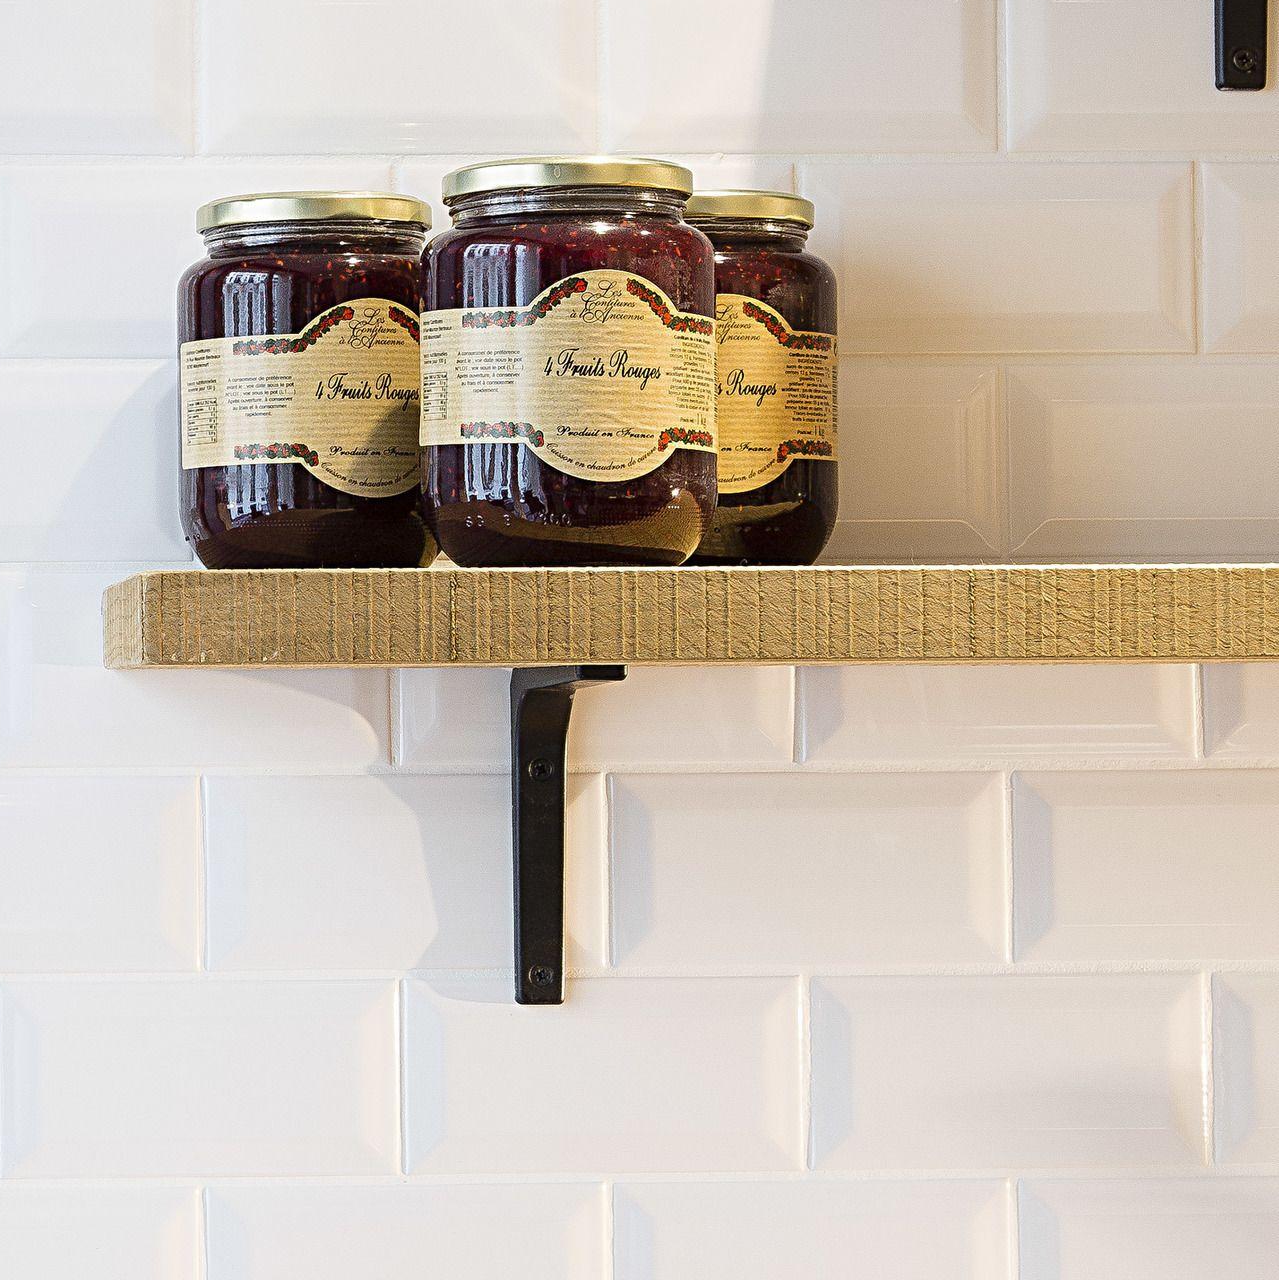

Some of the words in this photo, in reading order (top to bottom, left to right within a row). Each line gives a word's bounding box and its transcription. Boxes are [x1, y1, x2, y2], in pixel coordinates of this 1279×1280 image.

[598, 280, 622, 298] Les
[581, 292, 635, 311] Confitures
[364, 308, 385, 326] Les
[718, 322, 751, 334] nfitures
[544, 356, 553, 376] 4
[556, 348, 605, 377] Fruits
[608, 349, 661, 391] Rouges
[315, 381, 324, 400] 4
[327, 373, 372, 400] Fruits
[375, 373, 419, 412] Rouges
[726, 368, 776, 407] Rouges
[556, 425, 600, 437] Produit
[616, 427, 654, 439] France
[329, 446, 369, 456] Produit
[735, 441, 772, 452] France
[546, 443, 573, 464] Cuisson
[587, 461, 625, 471] chaudron
[718, 474, 747, 482] audron
